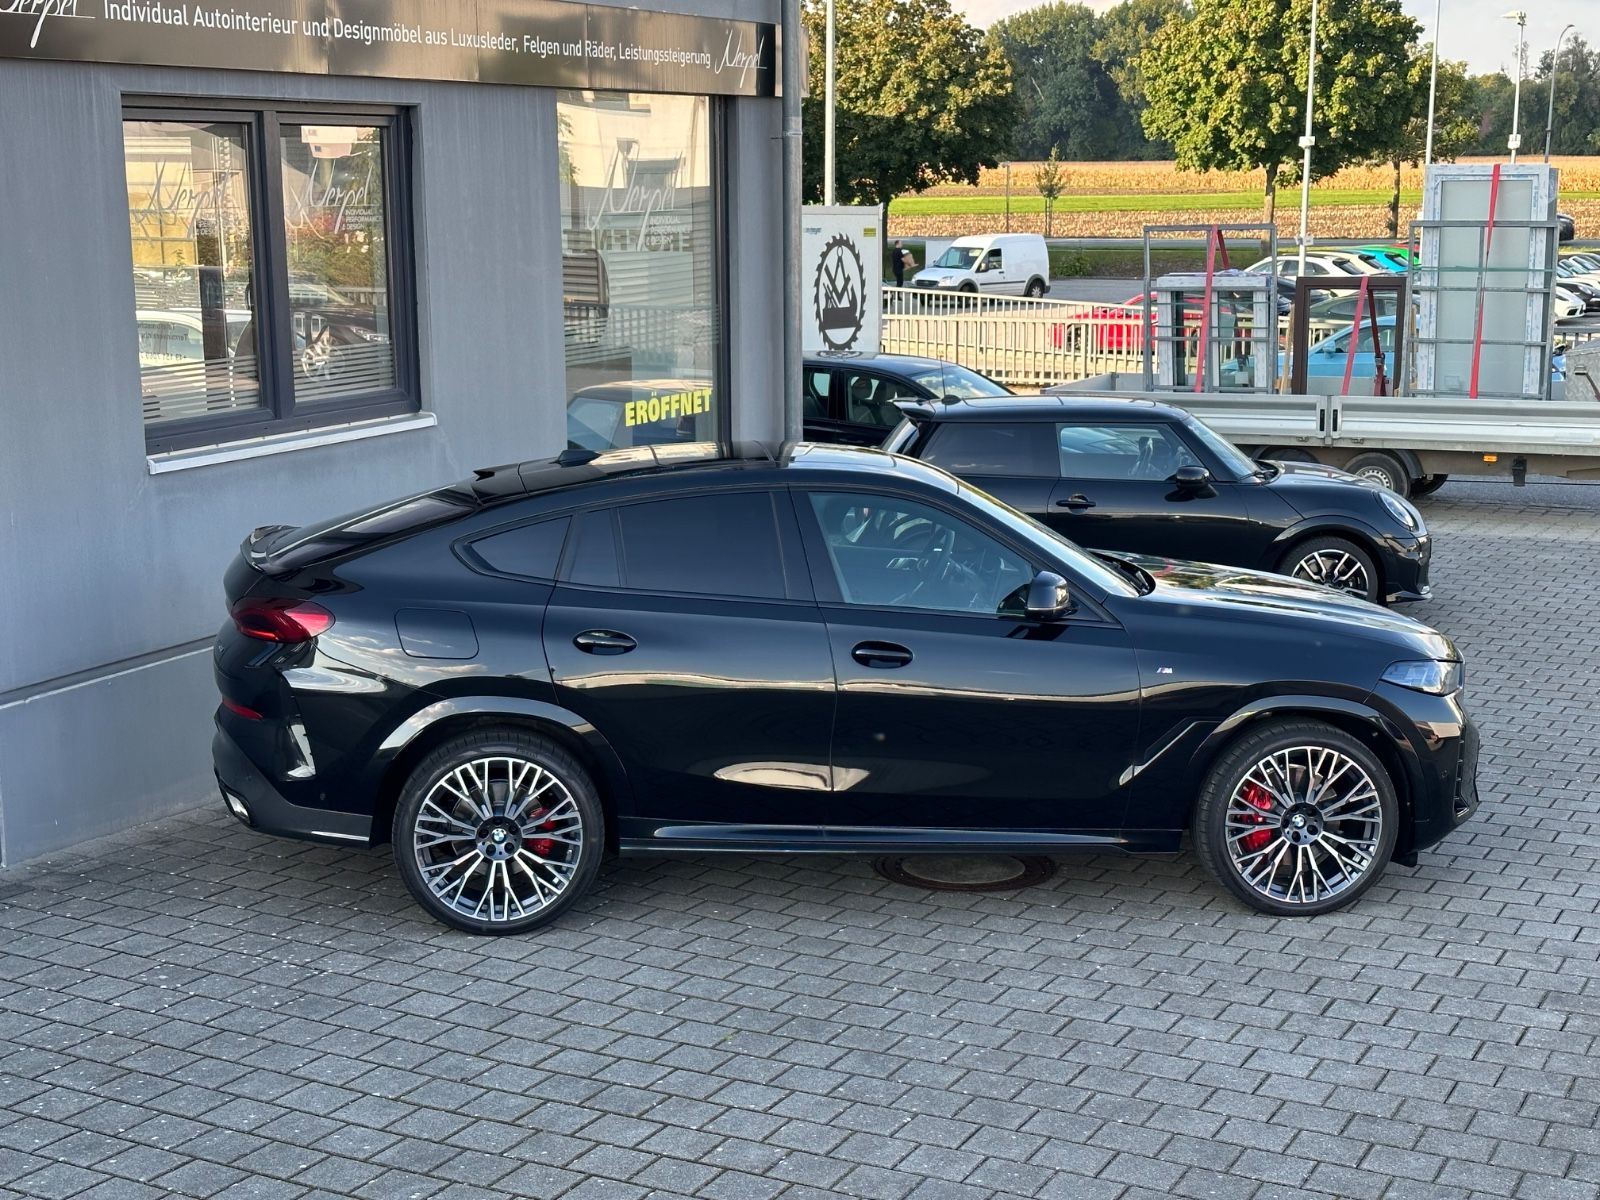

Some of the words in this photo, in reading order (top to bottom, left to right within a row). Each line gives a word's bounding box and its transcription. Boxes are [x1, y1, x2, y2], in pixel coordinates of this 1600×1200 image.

[104, 0, 189, 26] Individual
[193, 2, 298, 35] Autointerieur
[302, 17, 330, 37] und
[333, 18, 422, 46] Designmöbel
[425, 30, 448, 45] aus
[451, 27, 519, 53] Luxusleder,
[523, 34, 560, 59] Felgen
[562, 40, 582, 57] und
[585, 40, 617, 61] Räder,
[618, 43, 711, 69] Leistungssteigerung
[624, 387, 713, 428] ERÖFFNET
